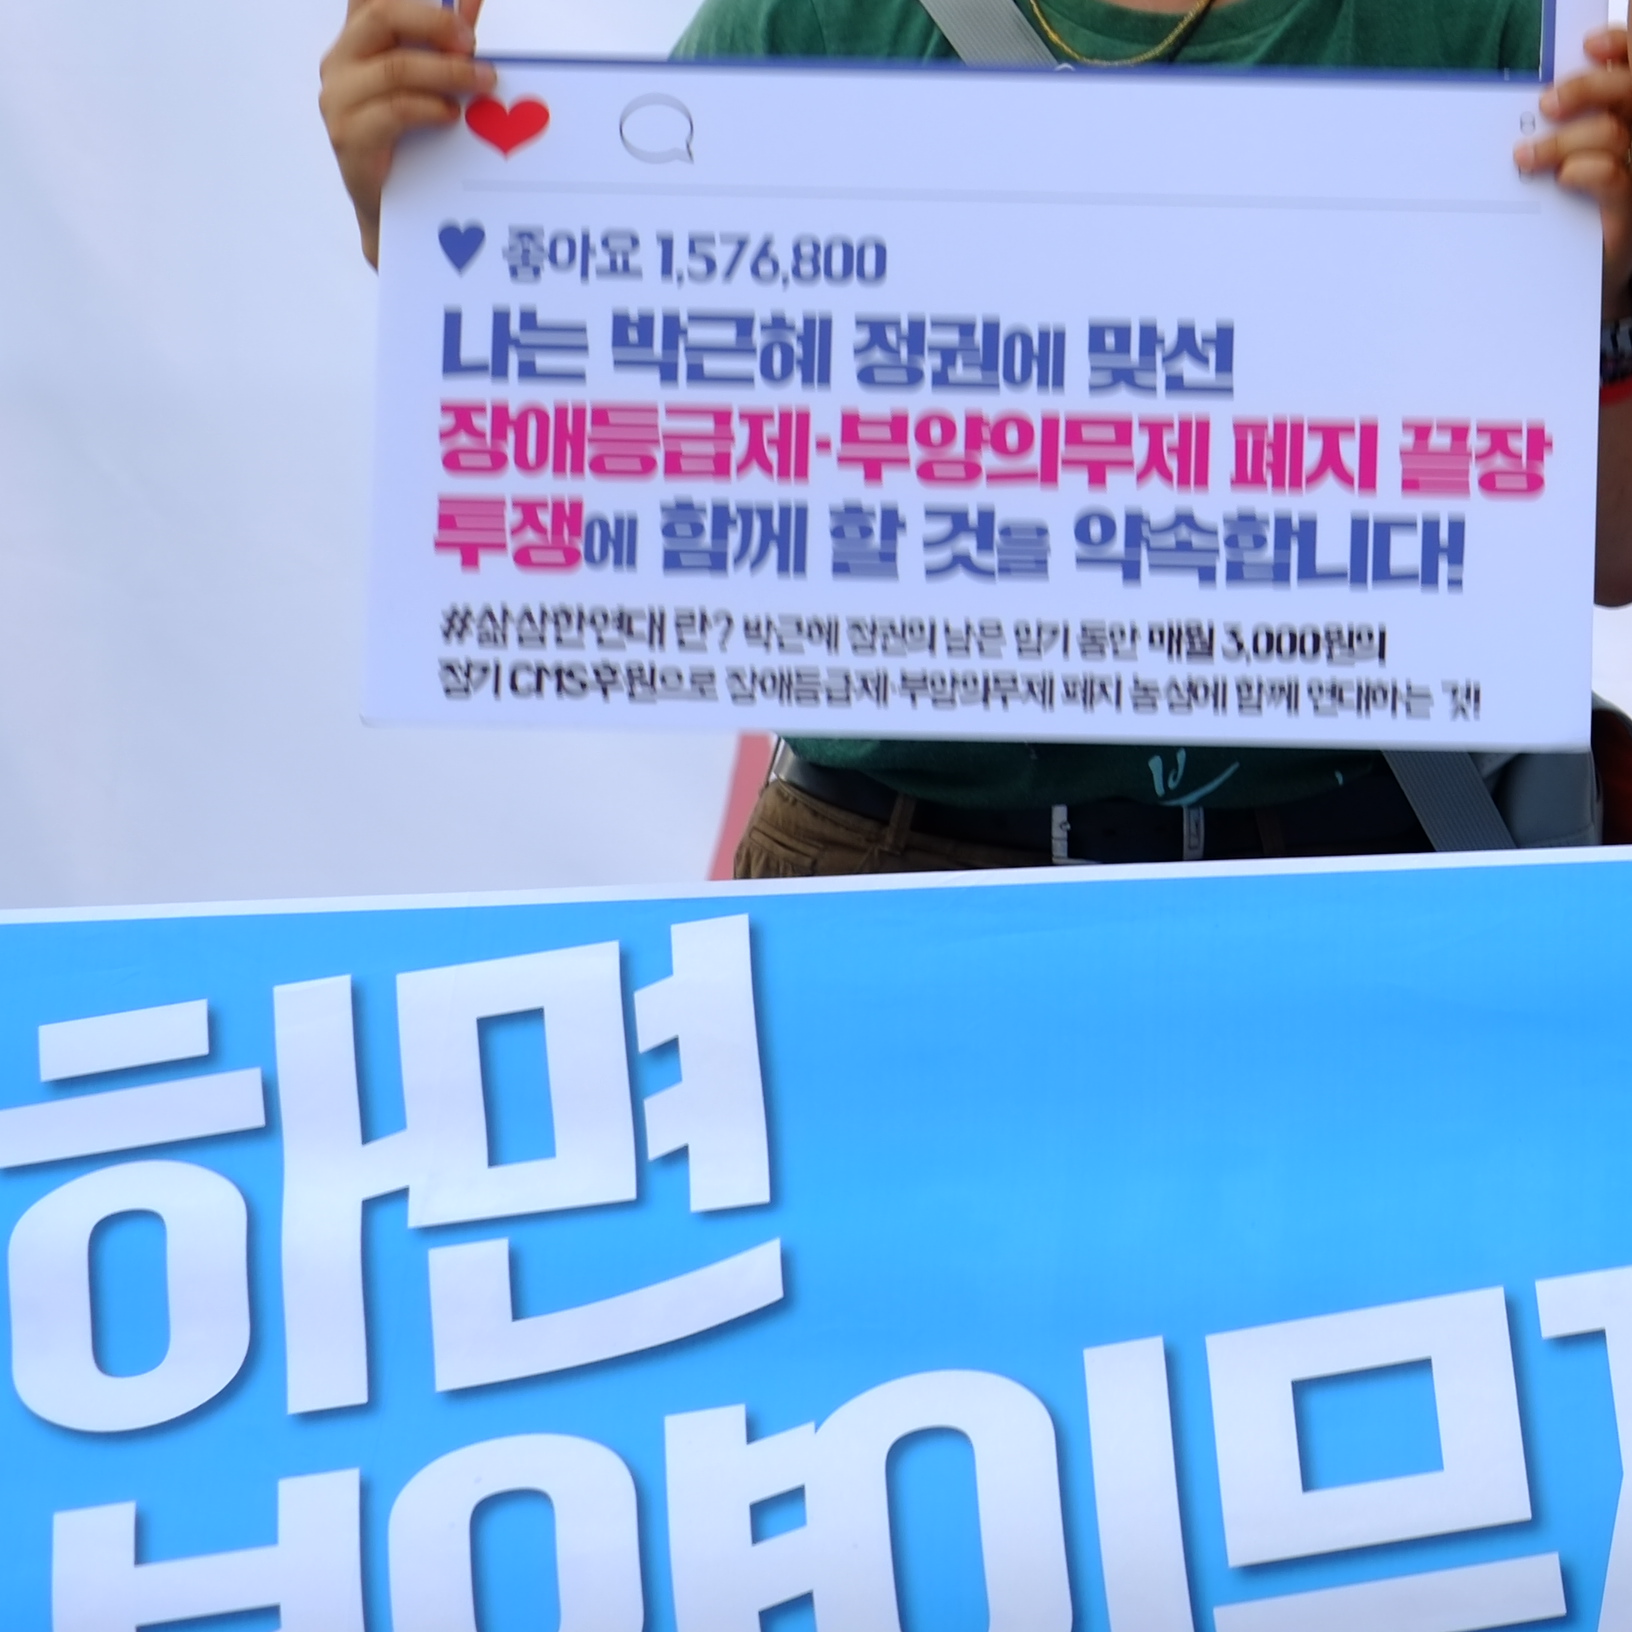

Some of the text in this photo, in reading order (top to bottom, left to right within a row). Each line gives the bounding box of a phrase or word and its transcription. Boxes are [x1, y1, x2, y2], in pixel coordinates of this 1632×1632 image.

[502, 226, 887, 289] 좋아요 1,576,800
[442, 306, 1234, 398] 나는 박근혜 정권에 맞선
[439, 400, 1553, 499] 장애등급제·부양의무제 폐지 끝장
[434, 495, 1465, 592] 투쟁에 함께 할 것을 약속합니다!
[0, 913, 785, 1415] 하면
